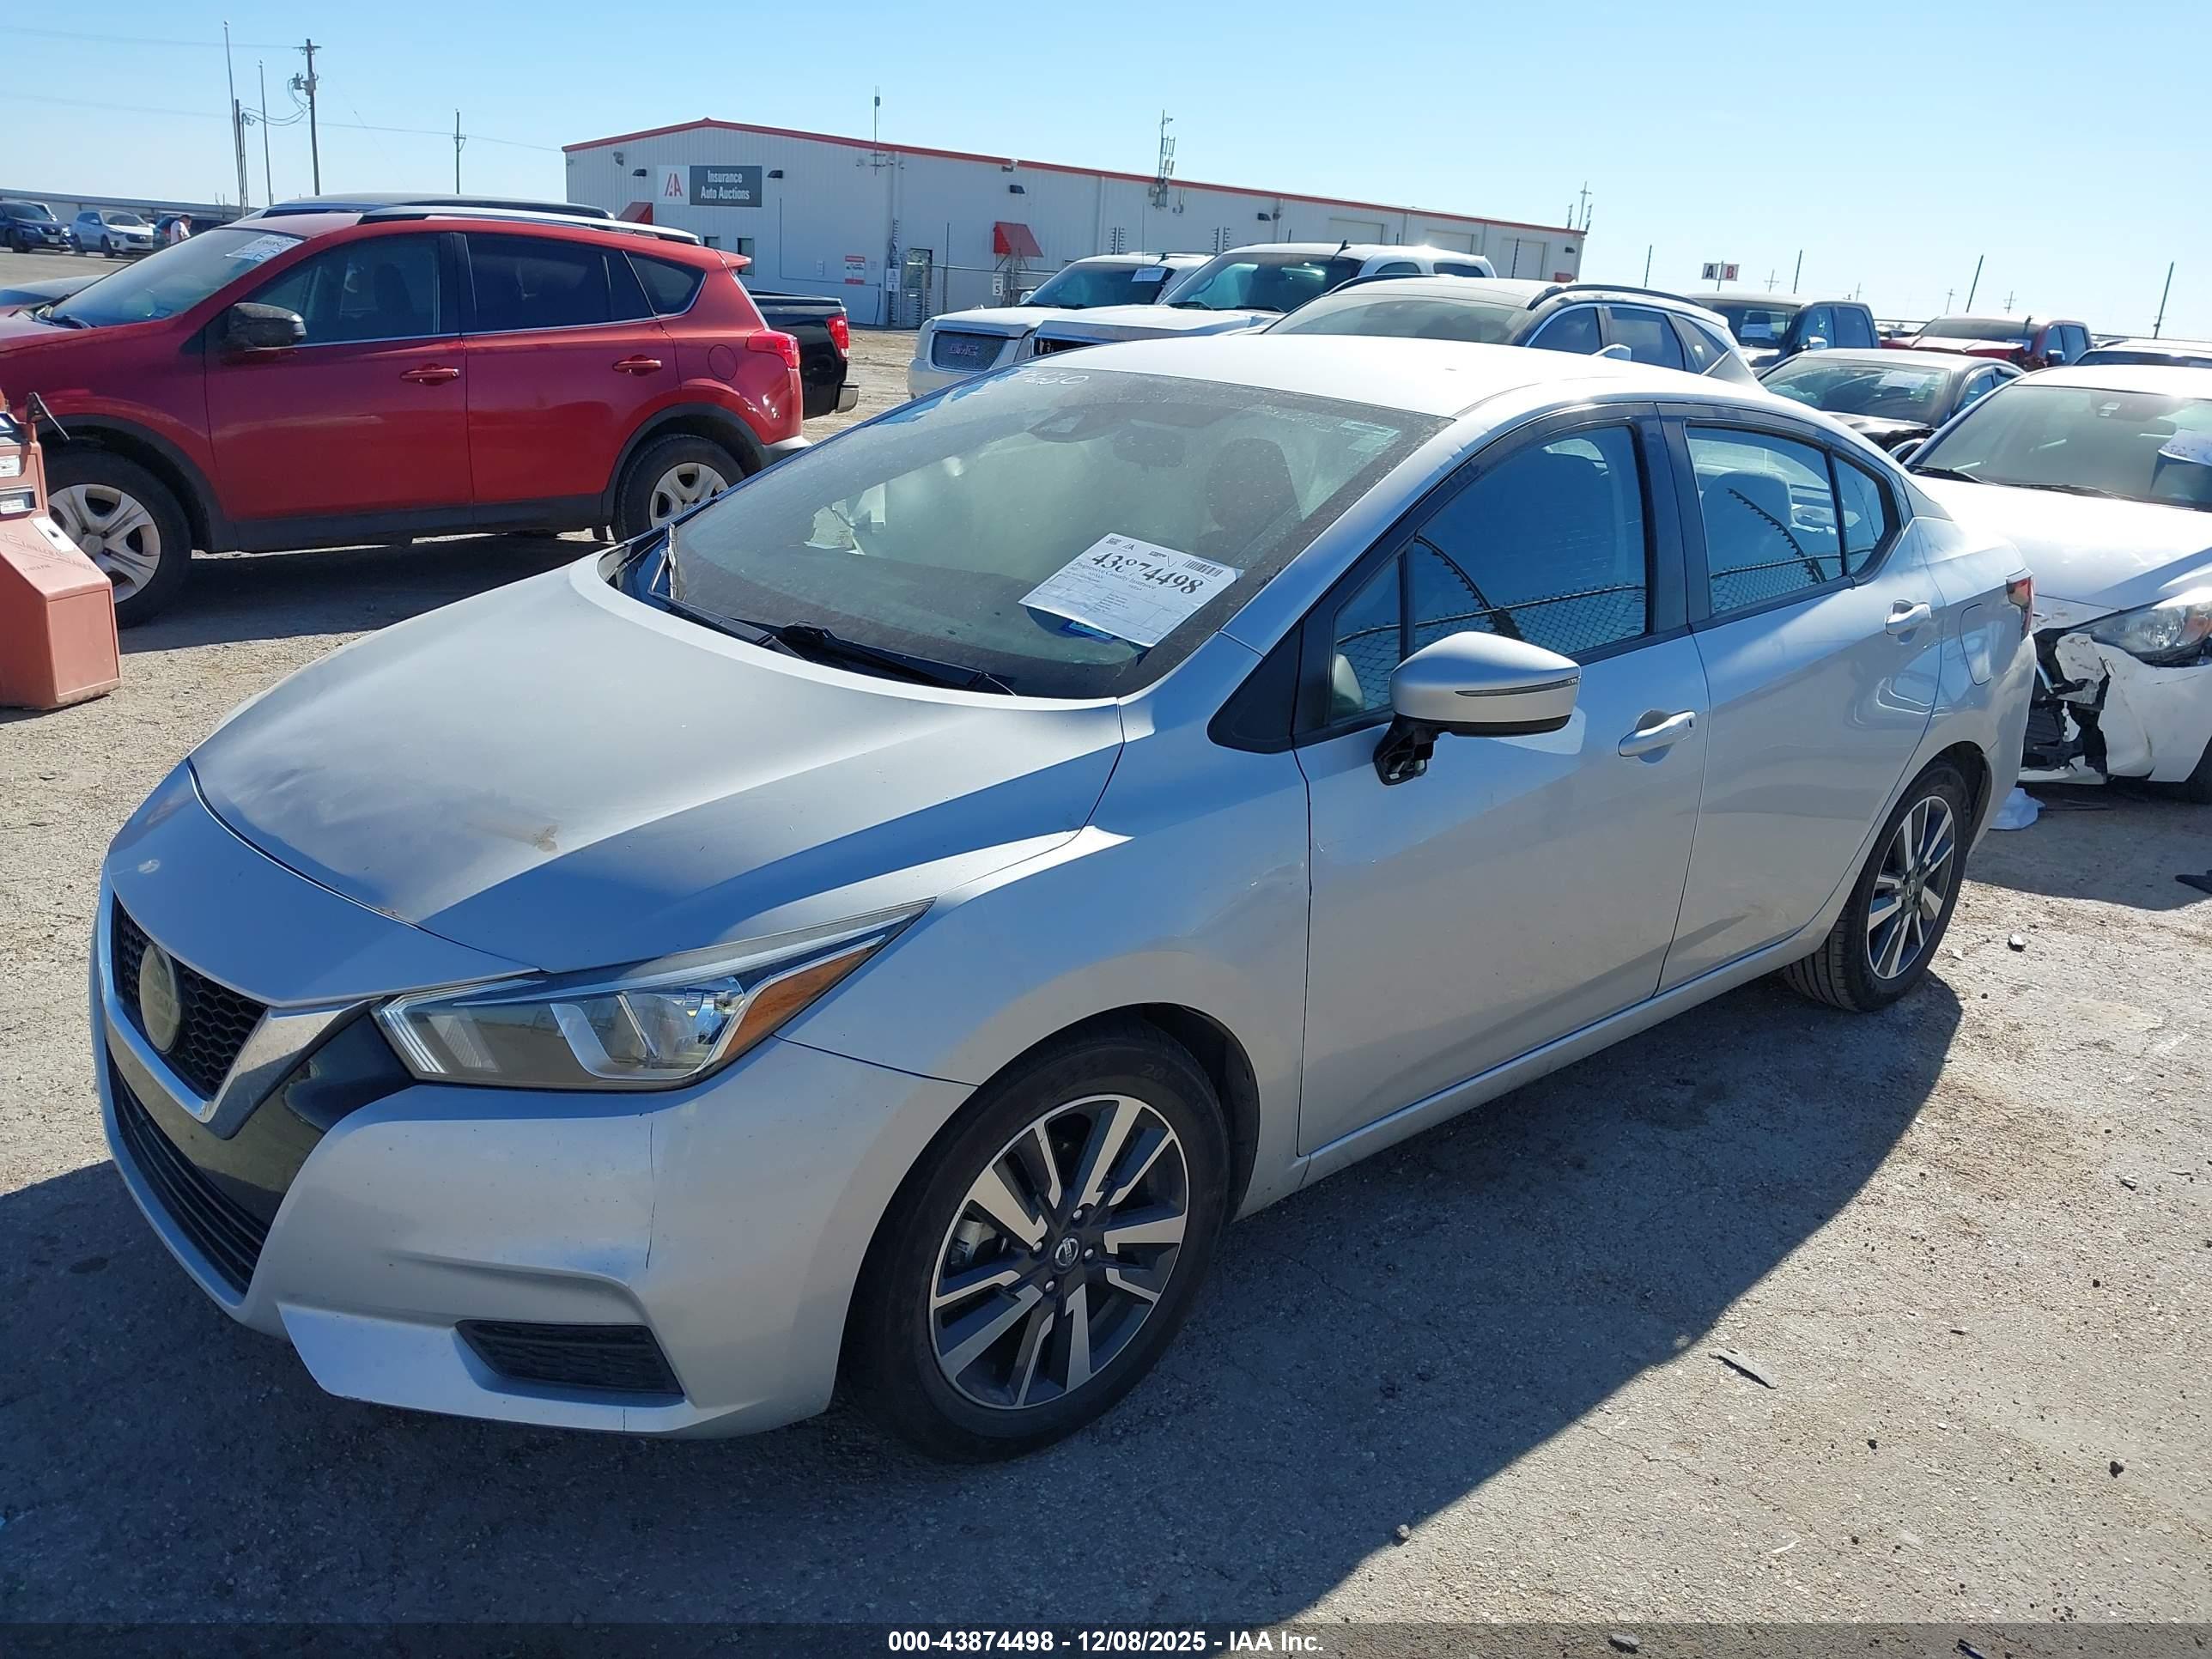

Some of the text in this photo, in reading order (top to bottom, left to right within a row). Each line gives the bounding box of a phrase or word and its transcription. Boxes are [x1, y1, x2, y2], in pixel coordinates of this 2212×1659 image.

[707, 169, 743, 184] Insurance
[700, 185, 750, 200] Auto Auctions
[1705, 264, 1714, 278] A
[1725, 265, 1735, 279] B
[995, 285, 1000, 295] 5
